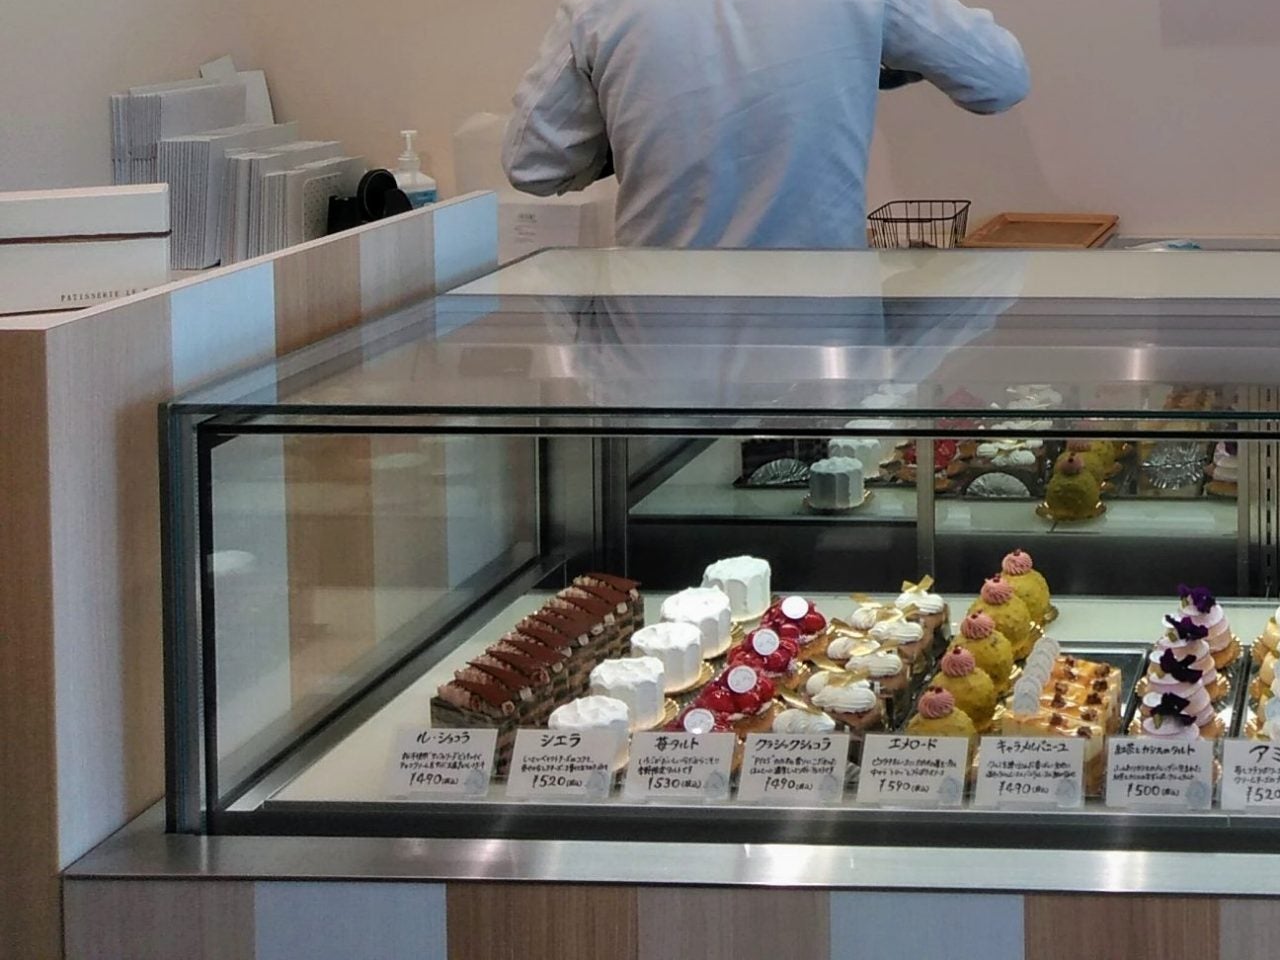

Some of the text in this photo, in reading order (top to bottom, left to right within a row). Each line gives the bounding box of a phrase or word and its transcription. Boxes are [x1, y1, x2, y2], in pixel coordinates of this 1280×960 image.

[60, 290, 119, 302] PATISSERIE
[540, 732, 582, 748] シエラ
[654, 736, 699, 751] 苺タルト
[755, 737, 832, 751] クラシックショコラ
